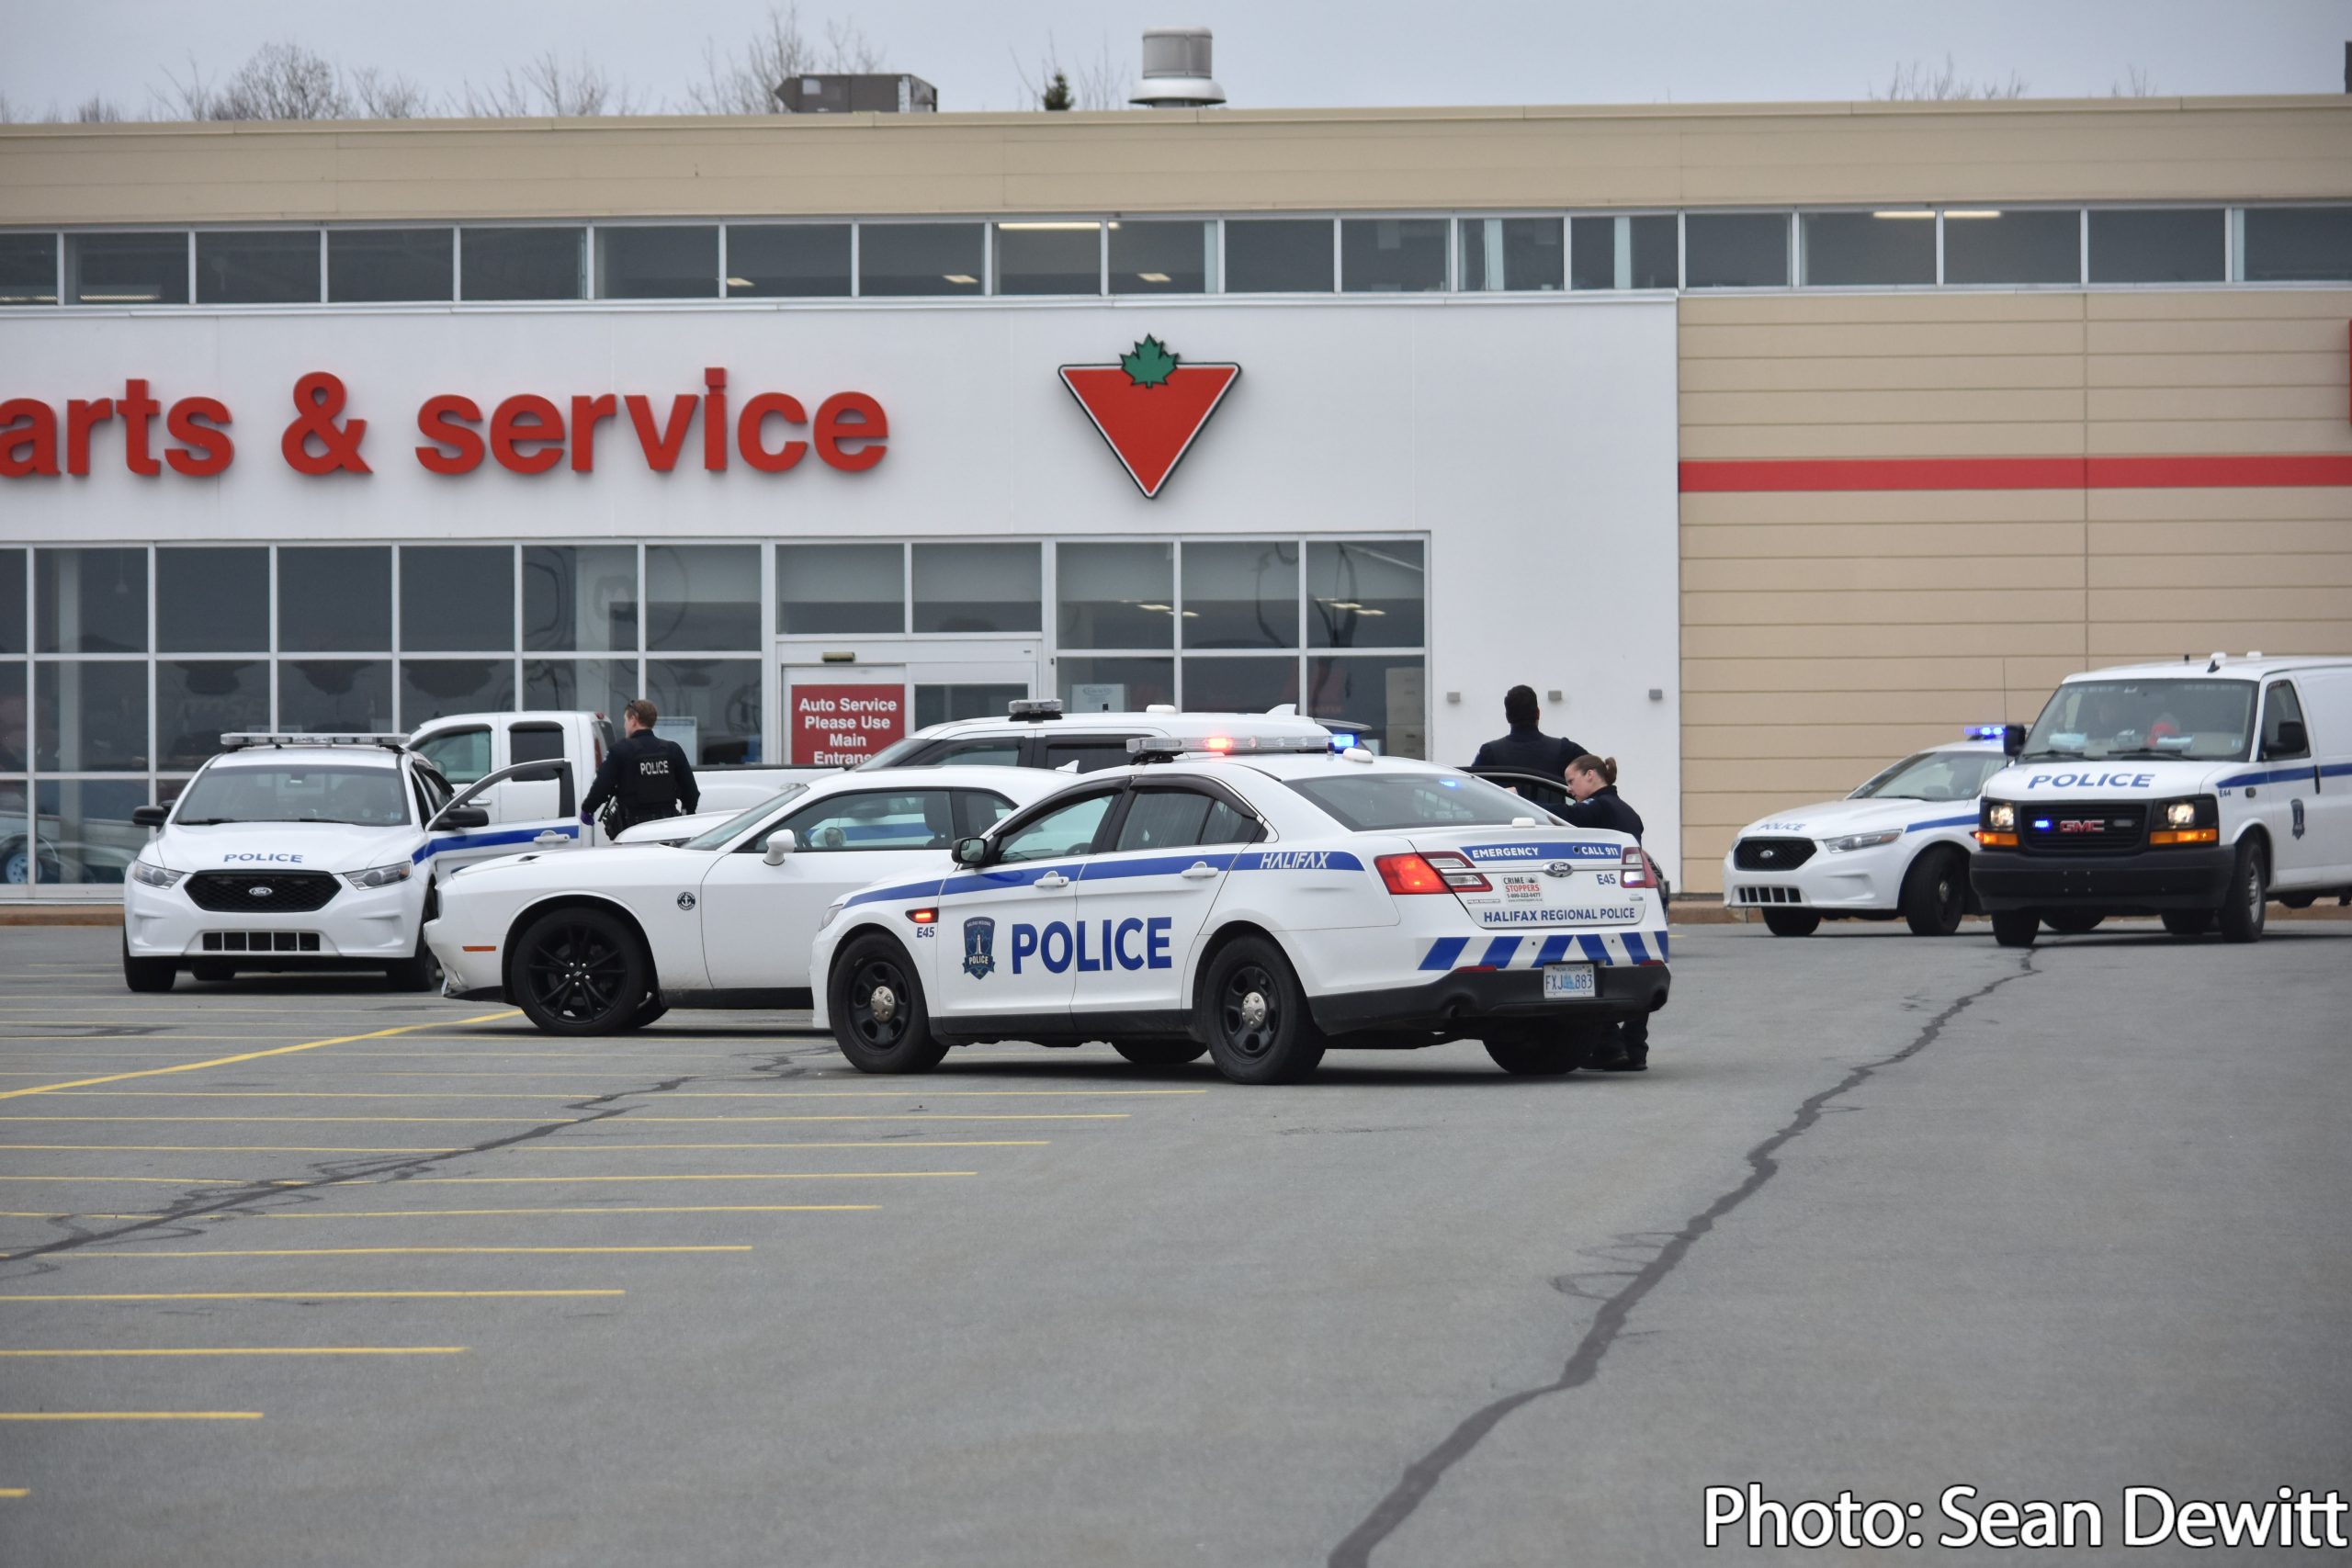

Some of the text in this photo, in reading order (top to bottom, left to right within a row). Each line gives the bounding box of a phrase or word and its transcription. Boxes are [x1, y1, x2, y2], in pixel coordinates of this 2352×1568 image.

[281, 371, 372, 476] &
[415, 367, 889, 474] service
[798, 697, 897, 712] Auto Service
[804, 716, 890, 729] Please Use
[830, 734, 866, 747] Main
[639, 760, 670, 775] POLICE
[2027, 773, 2155, 789] POLICE
[2219, 789, 2232, 797] E44
[2059, 819, 2106, 833] GMC
[223, 853, 303, 863] POLICE
[1472, 846, 1619, 859] EMERGENCY CALL 911
[1260, 852, 1330, 869] HALIFAX
[1554, 863, 1567, 871] Ford
[1596, 874, 1616, 885] E45
[1505, 884, 1540, 892] STOPPERS
[1484, 907, 1635, 922] HALIFAX REGIONAL POLICE
[916, 926, 935, 938] E45
[1012, 917, 1172, 975] POLICE
[968, 955, 989, 964] POLICE
[1545, 974, 1592, 990] FXJ 883
